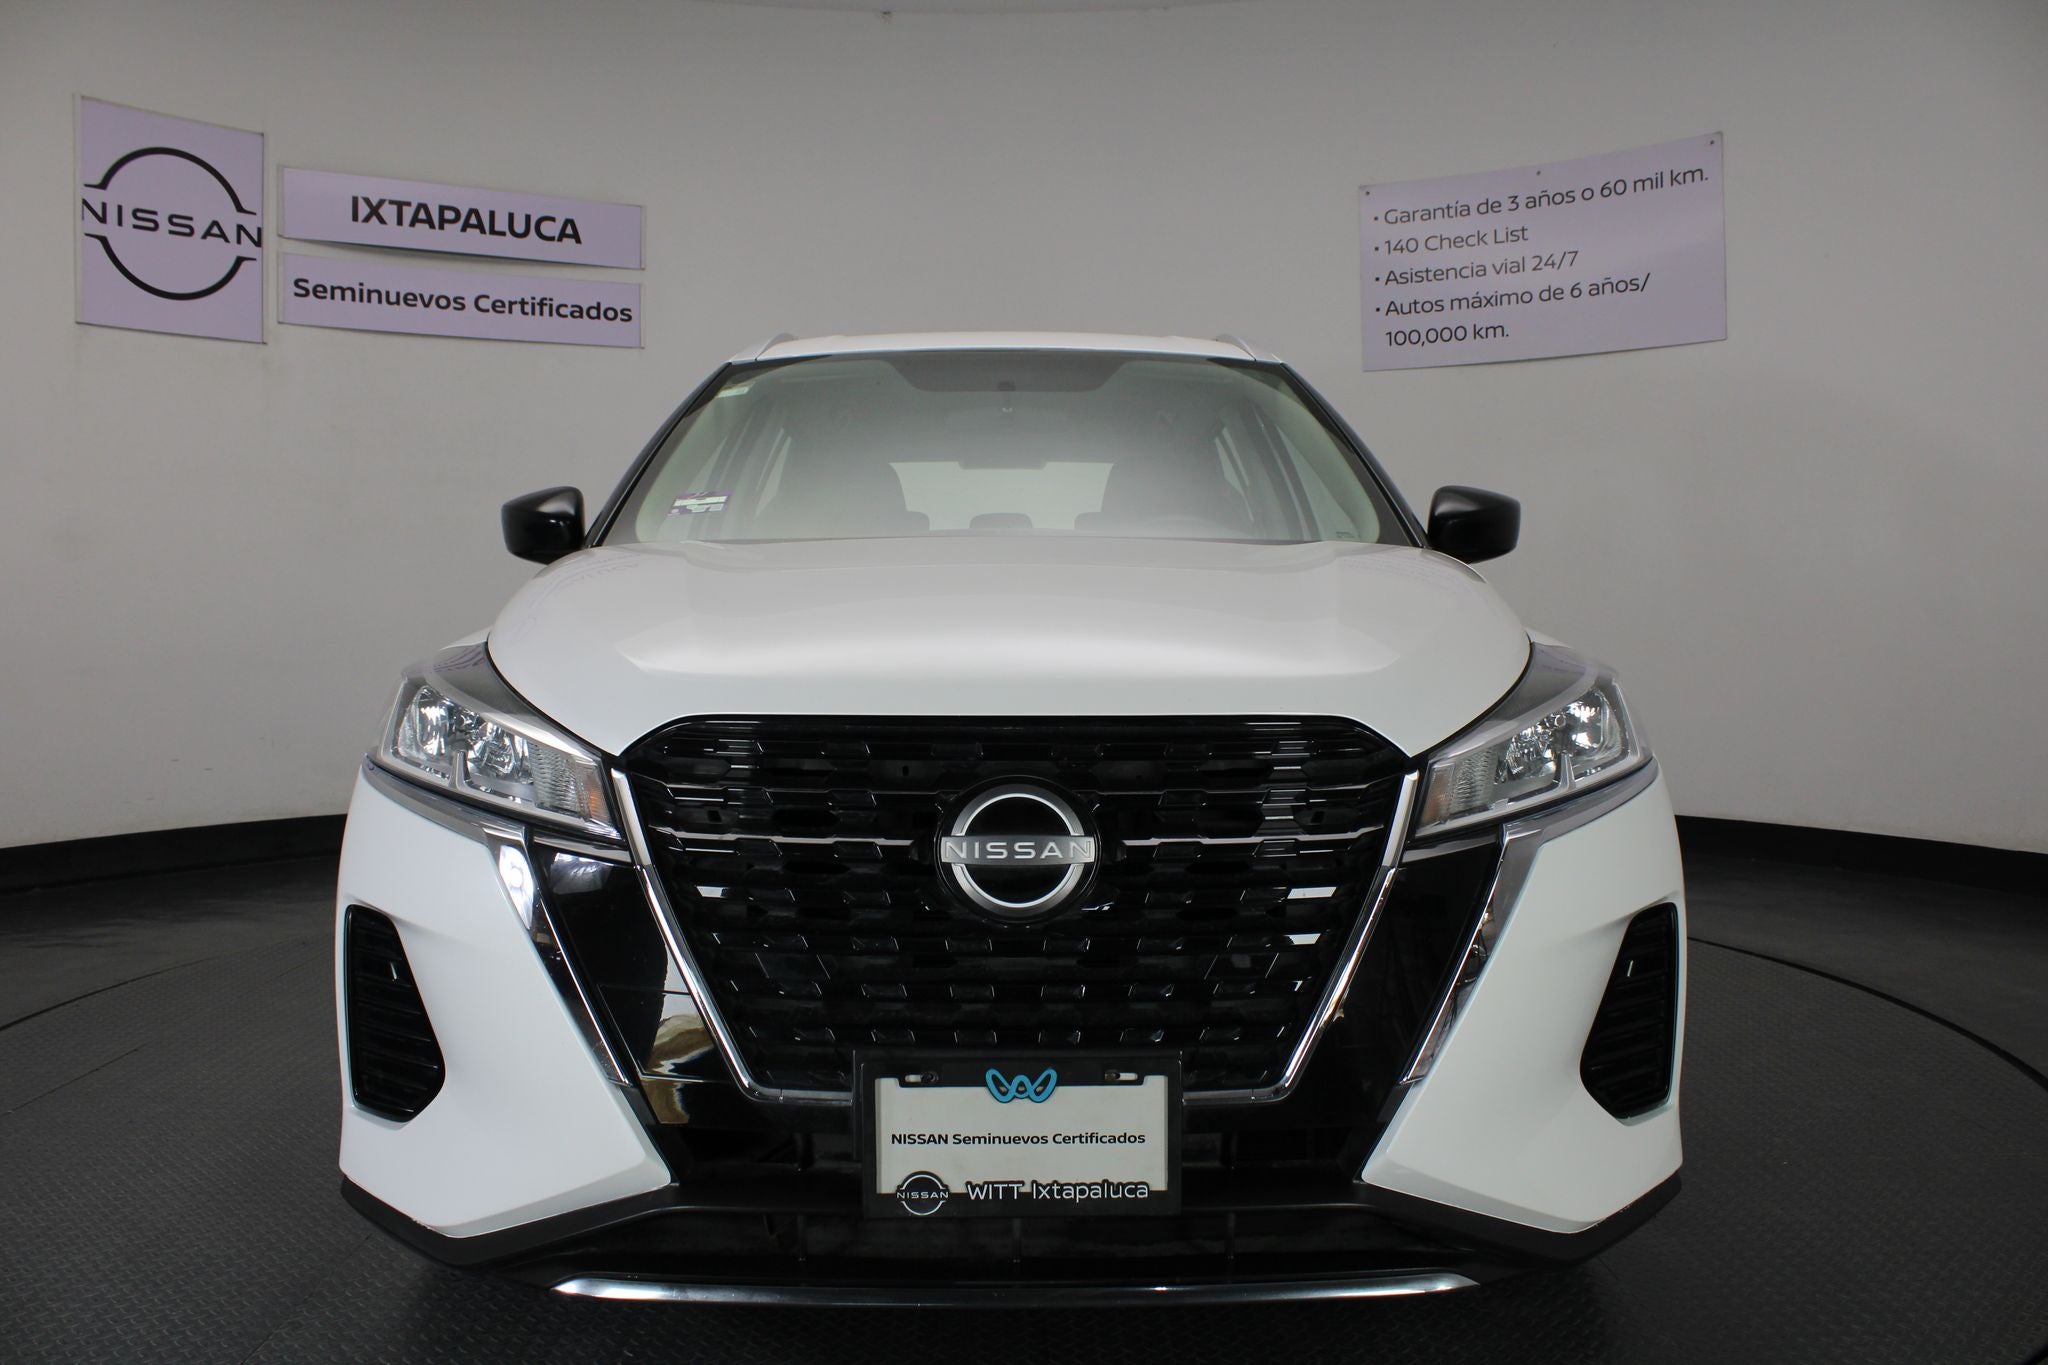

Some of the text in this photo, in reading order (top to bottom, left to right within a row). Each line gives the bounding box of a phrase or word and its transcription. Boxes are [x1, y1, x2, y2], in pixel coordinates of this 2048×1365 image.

[1384, 167, 1708, 225] Garantía de 3 años o 60 mil km.
[81, 197, 262, 248] NISSAN
[351, 195, 583, 245] IXTAPALUCA
[1384, 226, 1528, 255] 140 Check List
[1385, 250, 1578, 285] Asistencia vial 24/7
[293, 277, 633, 323] Seminuevos Certificados
[1385, 273, 1650, 316] Autos máximo de 6 años/
[1386, 323, 1509, 347] 100,000 km.
[945, 840, 1092, 859] NISSAN
[891, 1132, 1145, 1144] NISSAN Seminuevos Certificados
[897, 1191, 948, 1199] NISSAN
[967, 1182, 1149, 1202] WITT Ixtapaluca
